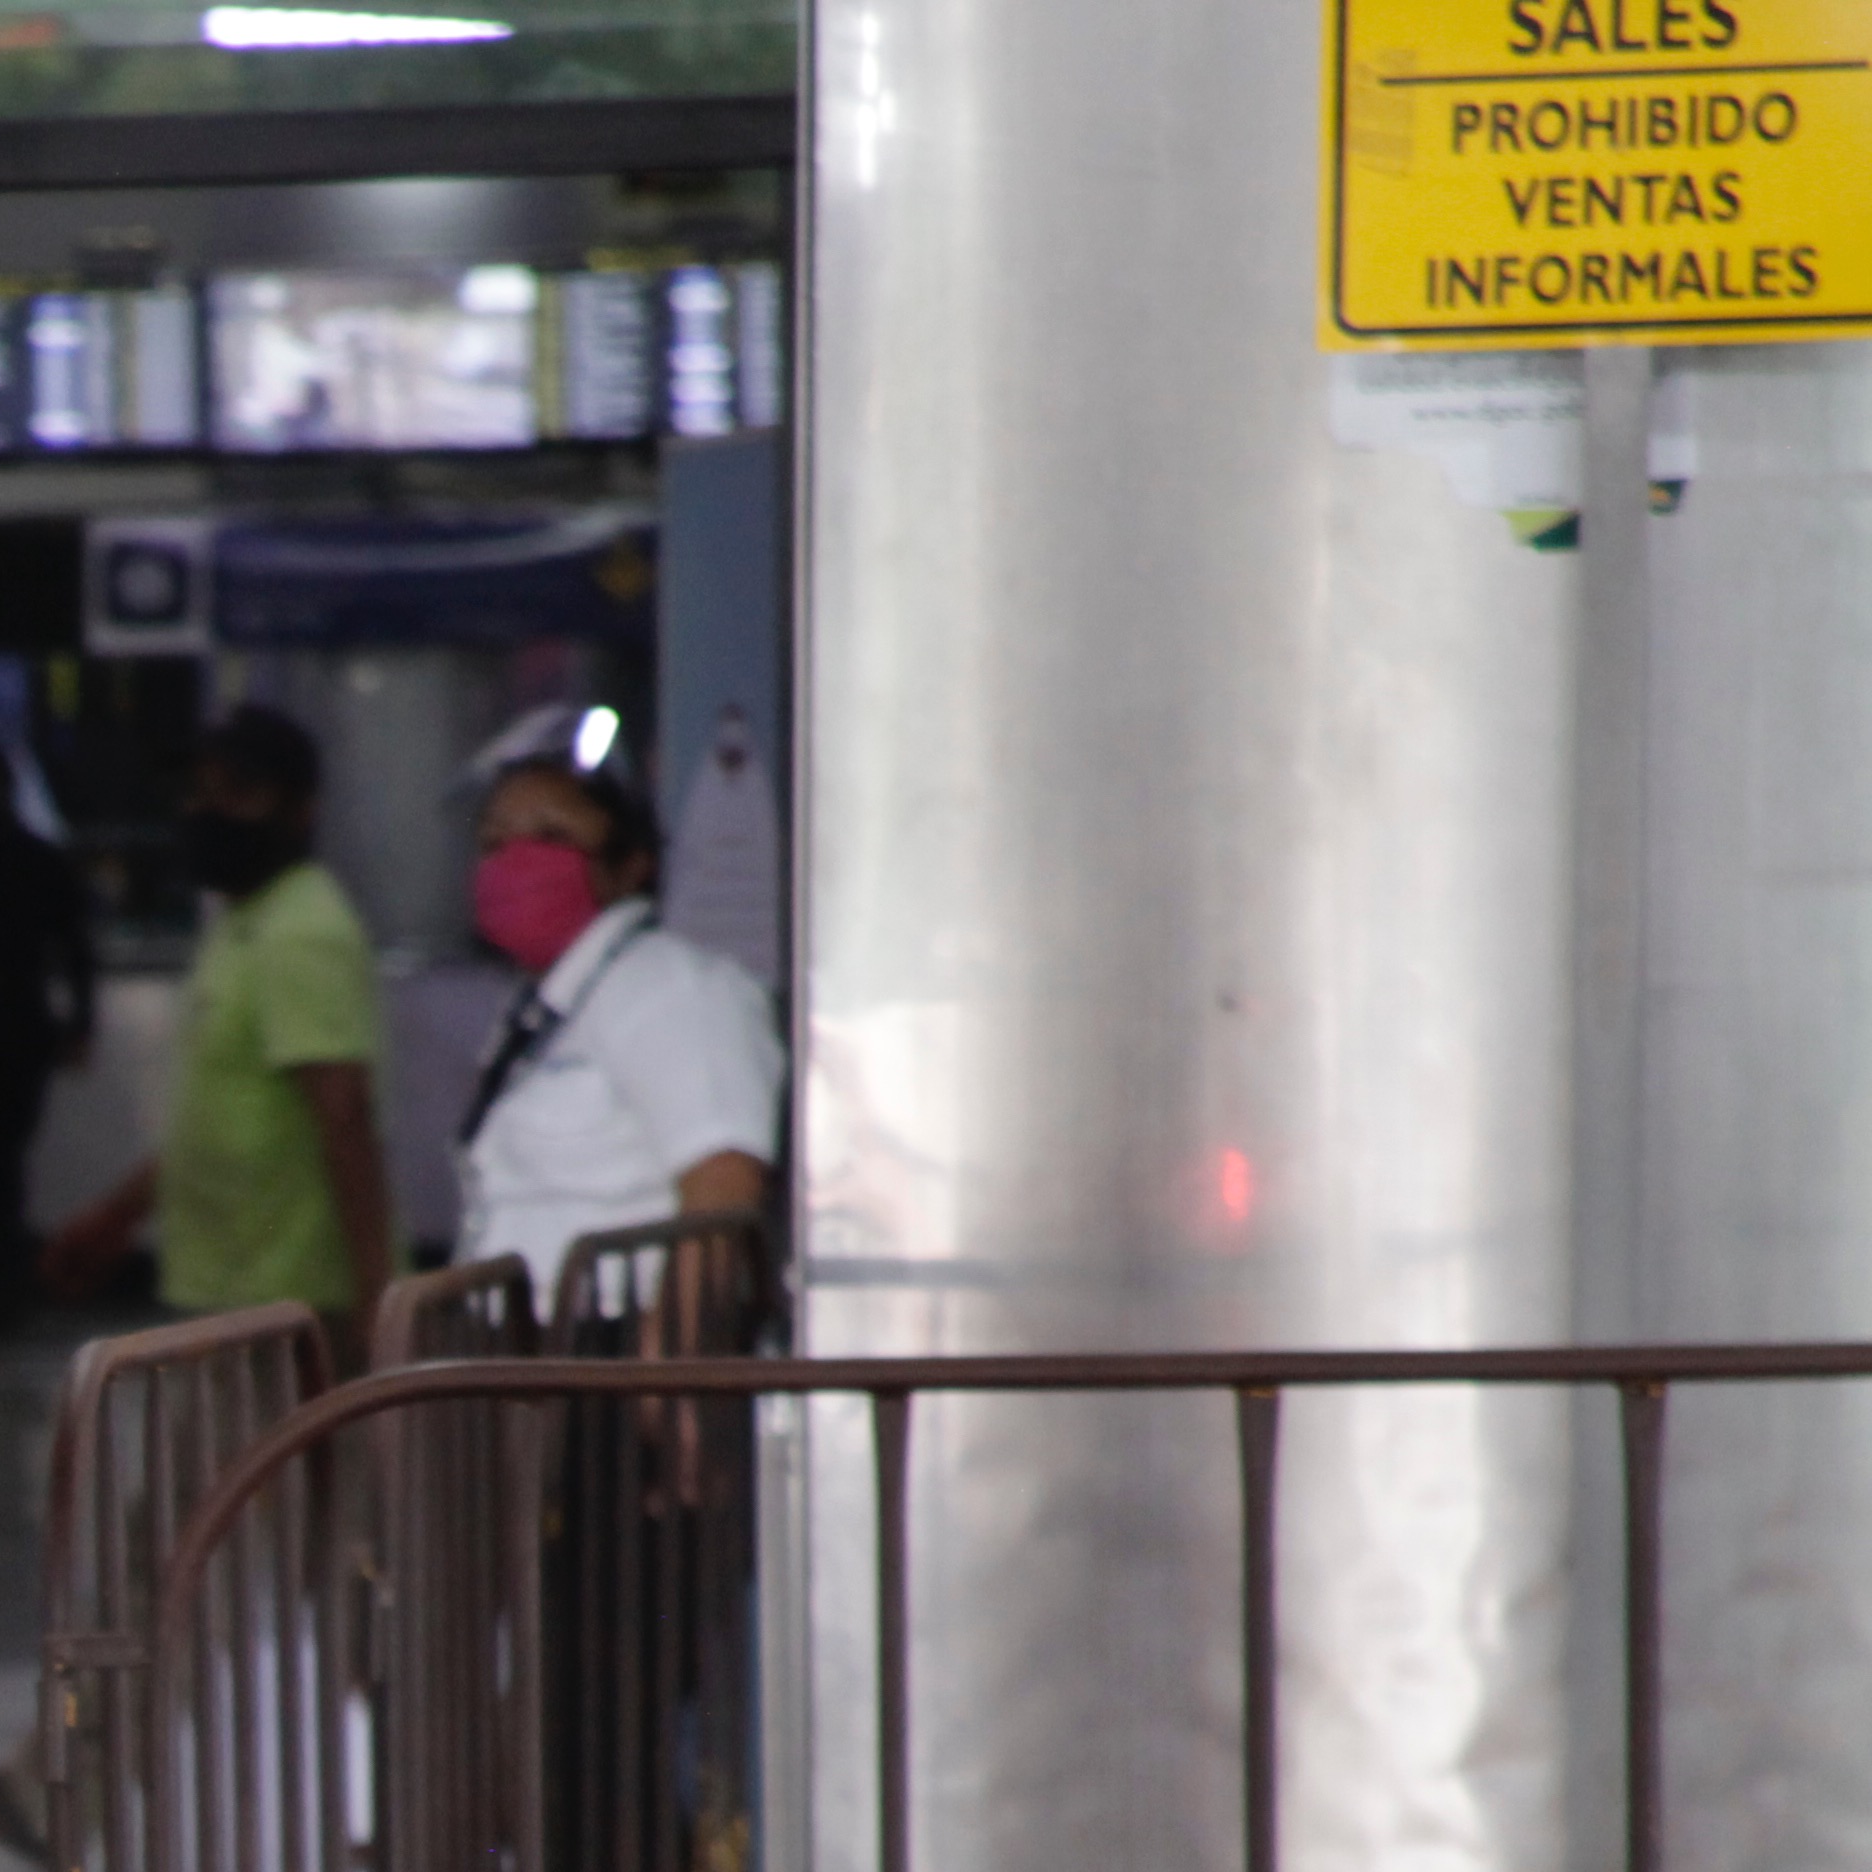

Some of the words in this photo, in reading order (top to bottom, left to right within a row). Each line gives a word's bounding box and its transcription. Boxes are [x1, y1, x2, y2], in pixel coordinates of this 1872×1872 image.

[1508, 0, 1738, 54] SALES
[1452, 91, 1798, 154] PROHIBIDO
[1504, 171, 1742, 228] VENTAS
[1427, 245, 1819, 308] INFORMALES
